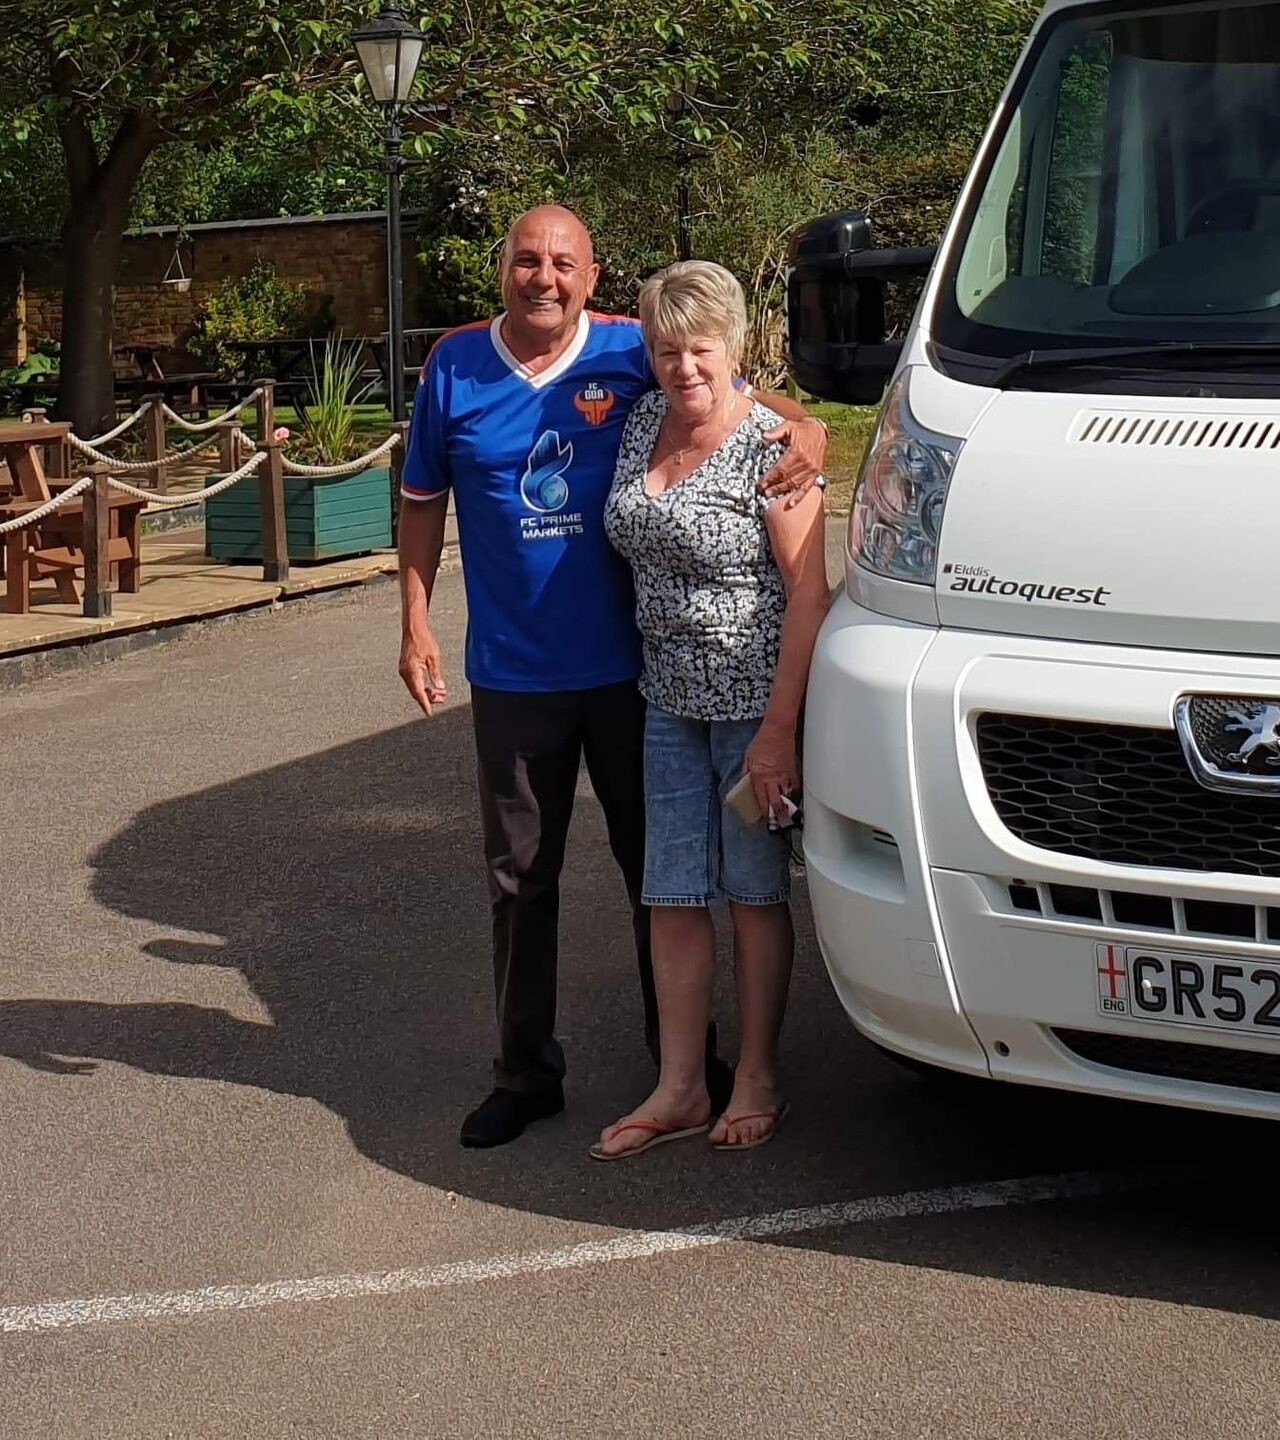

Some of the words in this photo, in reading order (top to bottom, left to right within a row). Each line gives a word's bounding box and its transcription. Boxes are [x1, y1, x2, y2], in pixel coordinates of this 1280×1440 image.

[520, 517, 537, 527] FC
[541, 513, 582, 526] PRIME
[522, 525, 584, 539] MARKETS
[954, 564, 990, 577] Elddis
[950, 576, 1111, 606] autoquest
[1103, 998, 1125, 1012] ENG
